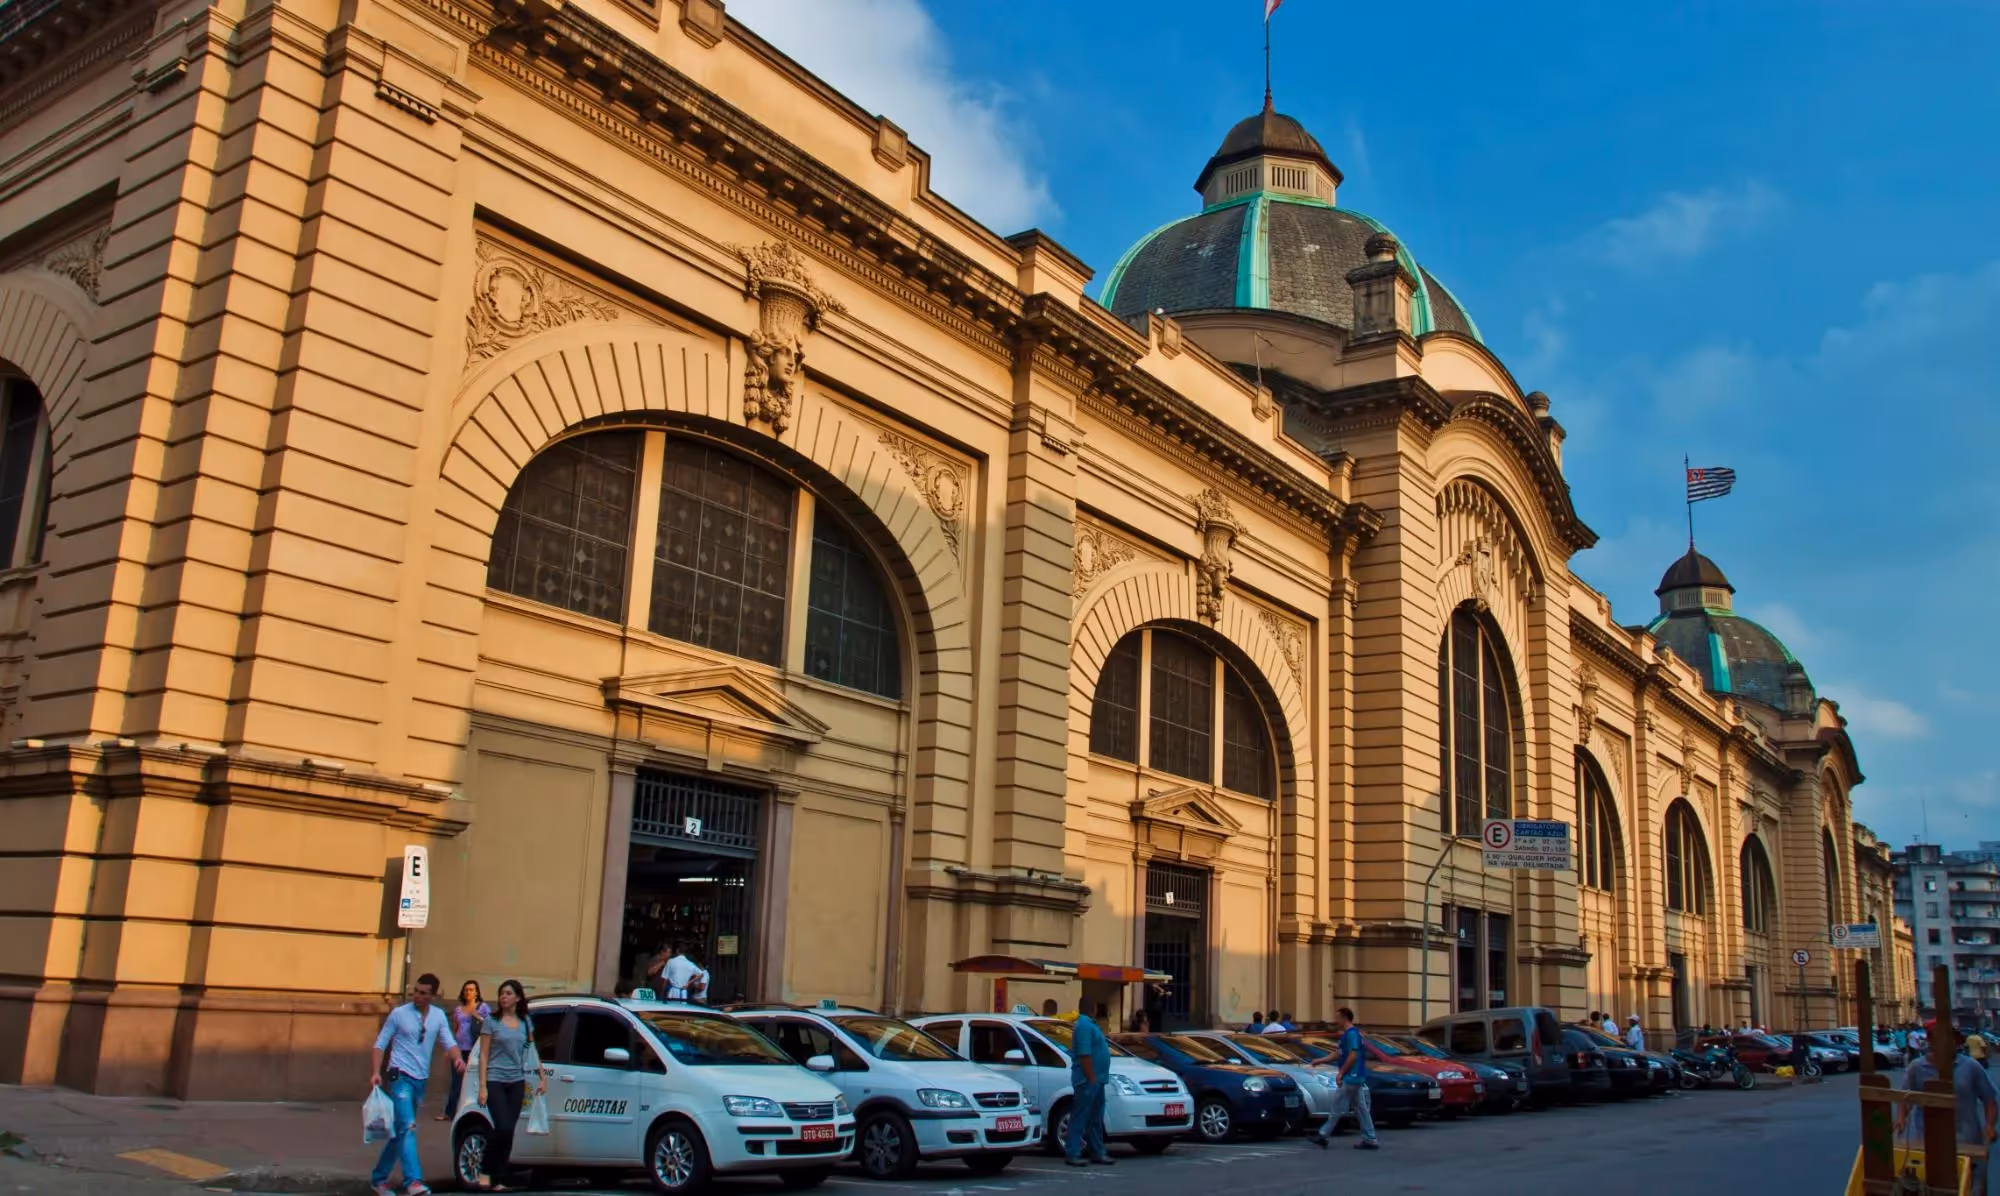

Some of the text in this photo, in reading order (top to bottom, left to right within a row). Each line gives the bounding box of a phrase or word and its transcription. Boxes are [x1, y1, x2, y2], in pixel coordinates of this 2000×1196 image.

[690, 822, 696, 833] 2
[1493, 828, 1502, 842] E
[412, 856, 421, 876] E
[639, 990, 654, 1000] TAXI
[564, 1098, 628, 1114] COOPERTAX
